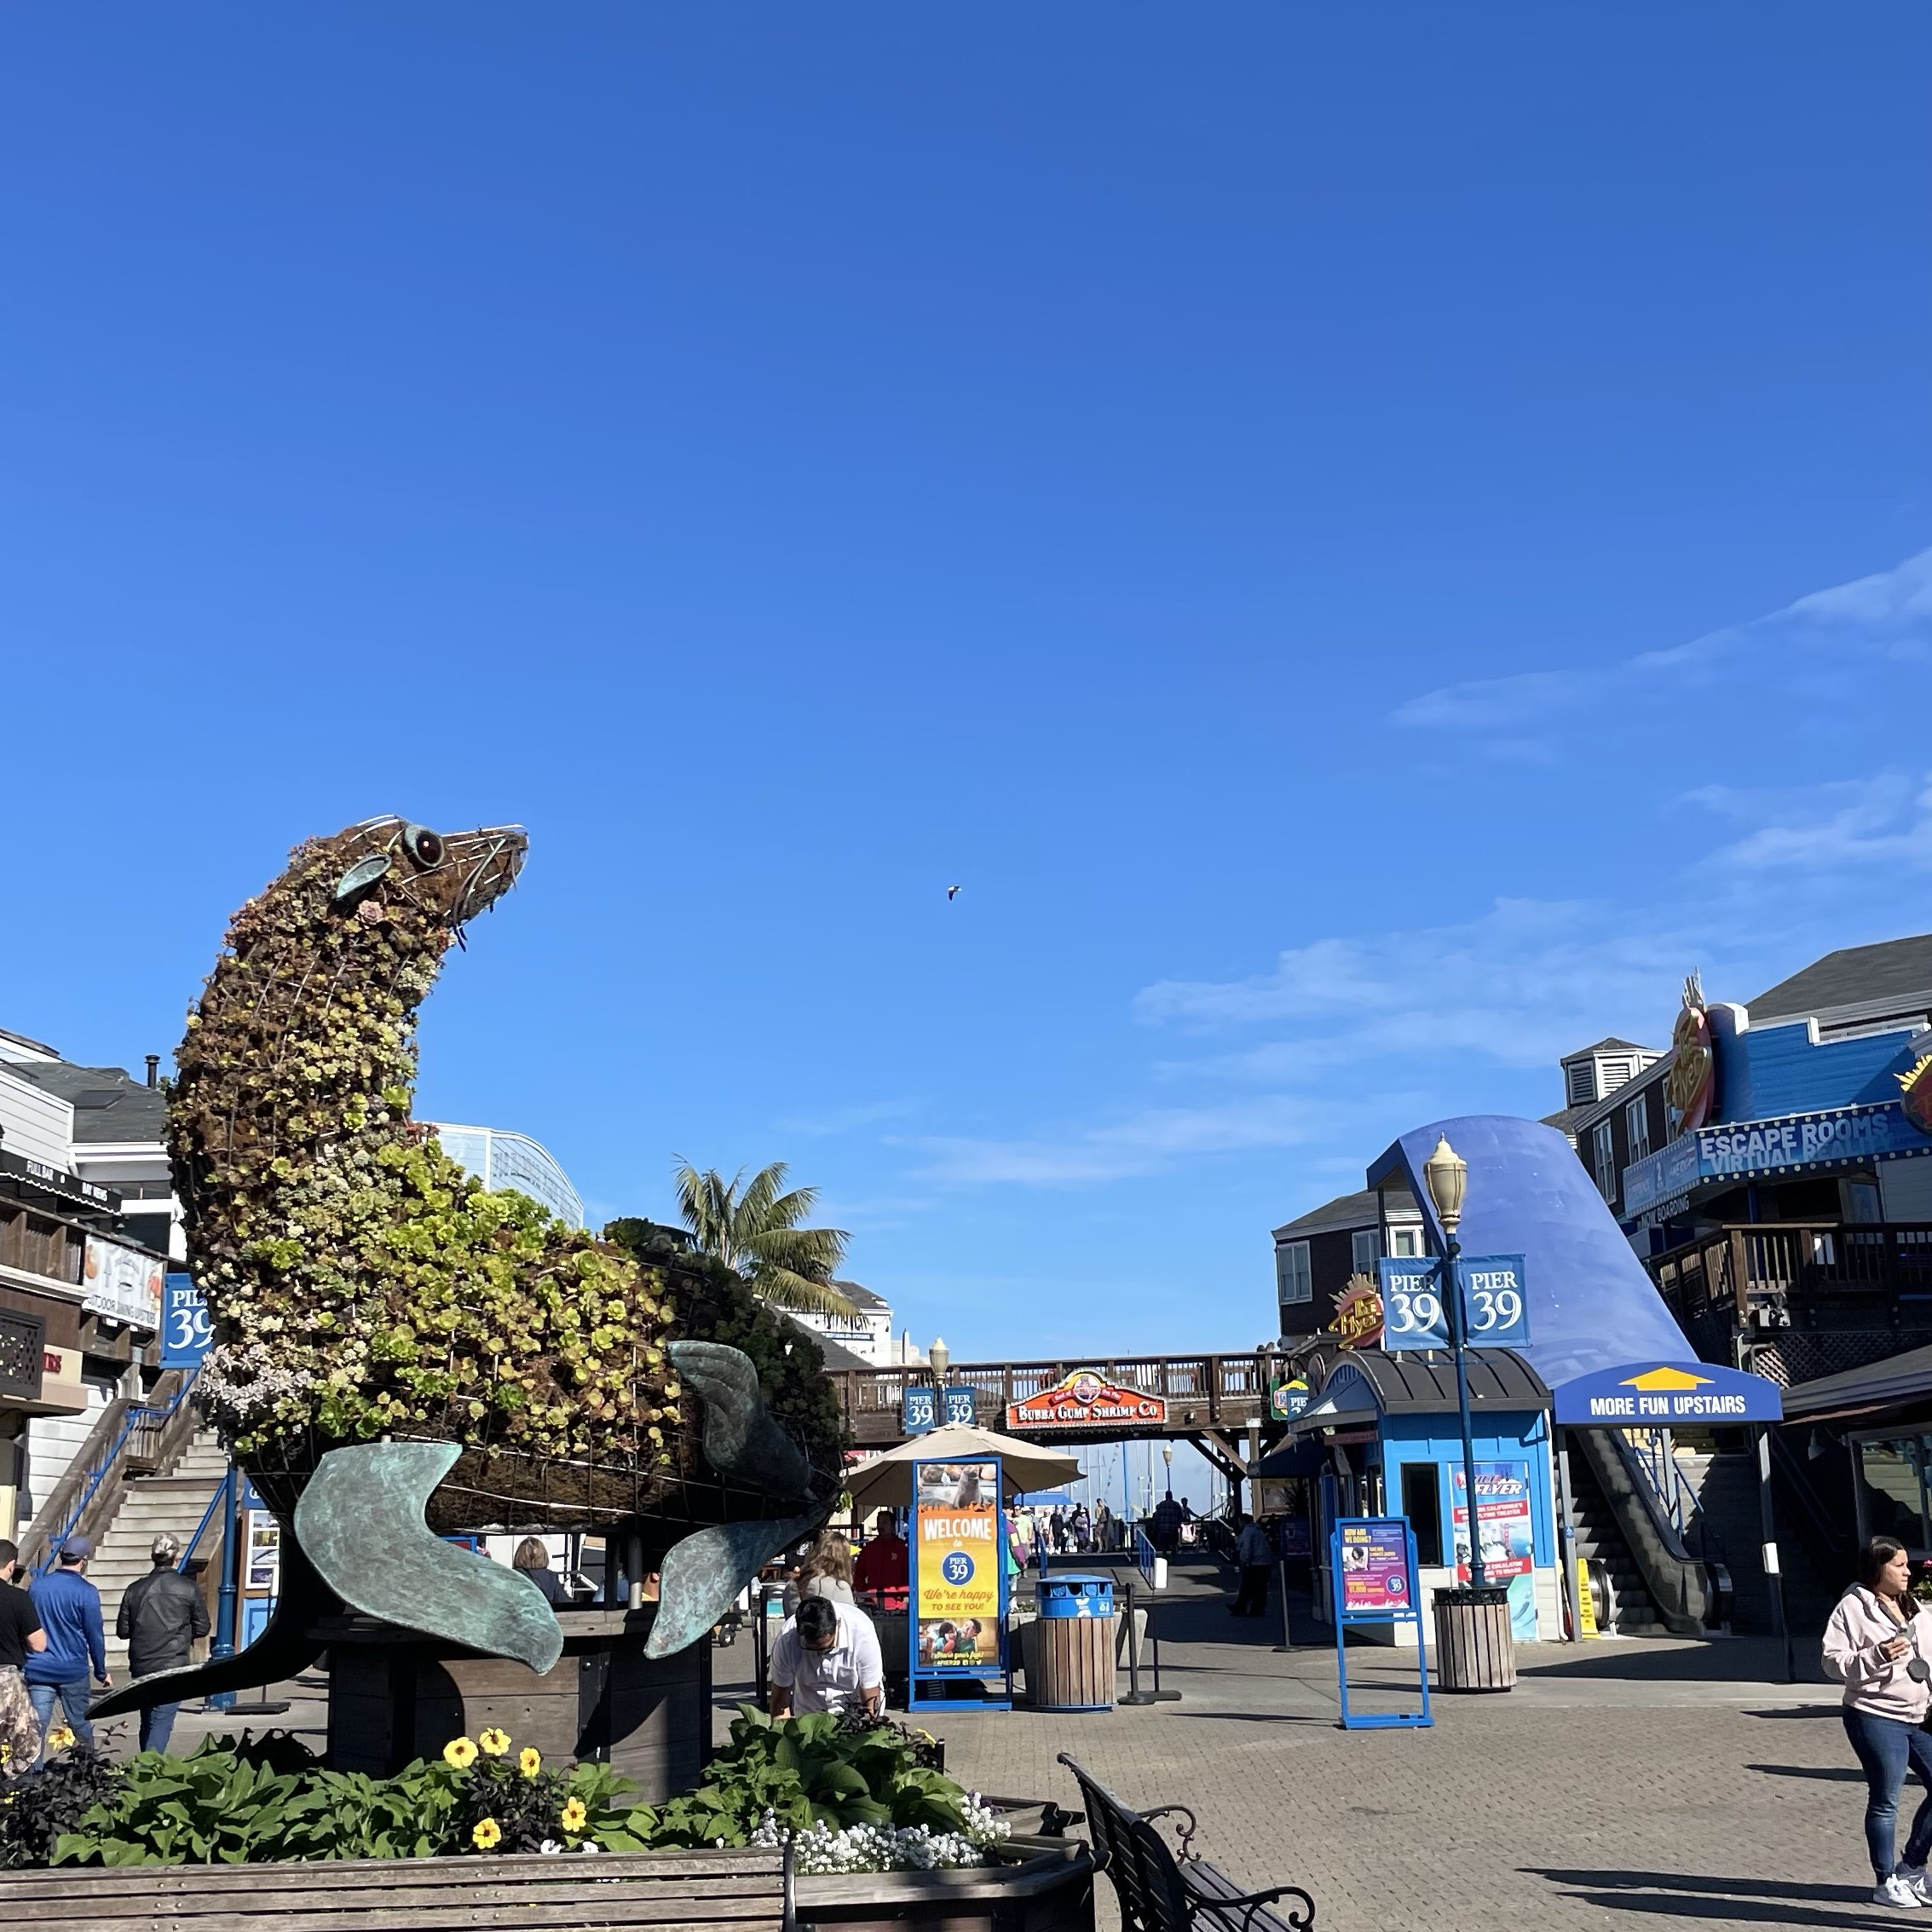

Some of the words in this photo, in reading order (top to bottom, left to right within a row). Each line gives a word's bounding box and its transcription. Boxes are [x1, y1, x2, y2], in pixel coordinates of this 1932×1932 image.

[1700, 1126, 1797, 1161] ESCAPE
[1802, 1113, 1889, 1147] ROOMS
[1710, 1146, 1799, 1176] VIRTUAL
[1657, 1194, 1690, 1222] BOARDING
[1389, 1275, 1437, 1292] PIER
[1470, 1271, 1518, 1290] PIER
[1390, 1293, 1440, 1333] 39
[1473, 1289, 1522, 1331] 39
[168, 1308, 216, 1349] 39
[908, 1395, 931, 1405] PIER
[948, 1394, 971, 1404] PIER
[1590, 1397, 1635, 1416] MORE
[1640, 1396, 1670, 1416] FUN
[1674, 1395, 1746, 1415] UPSTAIRS
[908, 1404, 933, 1426] 39
[949, 1404, 972, 1424] 39
[1018, 1405, 1055, 1422] BUBBA
[1057, 1404, 1090, 1420] GUMP
[1092, 1403, 1135, 1419] SHRIMP
[1475, 1483, 1523, 1496] FLYER
[924, 1518, 992, 1541] WELCOME
[953, 1539, 963, 1548] to
[949, 1564, 969, 1581] 39
[924, 1589, 958, 1600] We're
[959, 1589, 995, 1602] happy
[1390, 1583, 1402, 1592] 39
